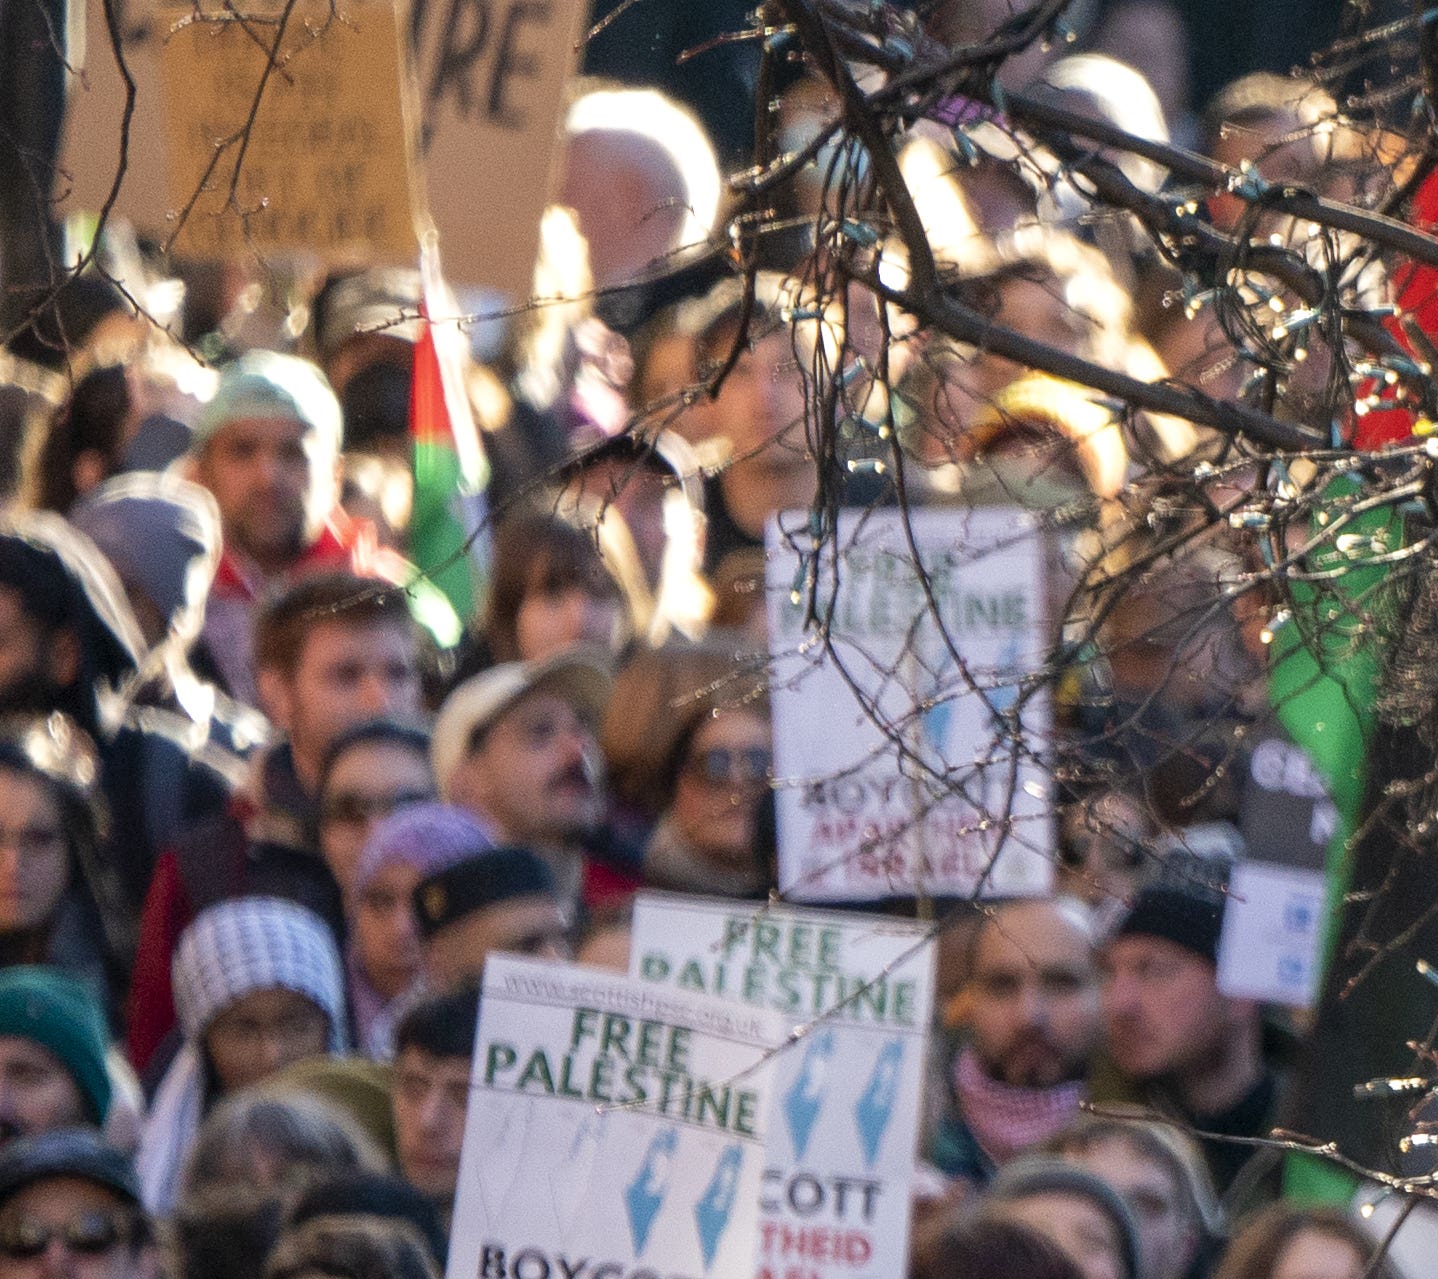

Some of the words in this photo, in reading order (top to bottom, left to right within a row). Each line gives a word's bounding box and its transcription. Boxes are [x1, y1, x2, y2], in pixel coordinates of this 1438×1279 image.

[720, 914, 842, 967] FREE
[638, 953, 916, 1026] PALESTINE
[570, 1006, 694, 1073] FREE
[484, 1043, 758, 1137] PALESTINE
